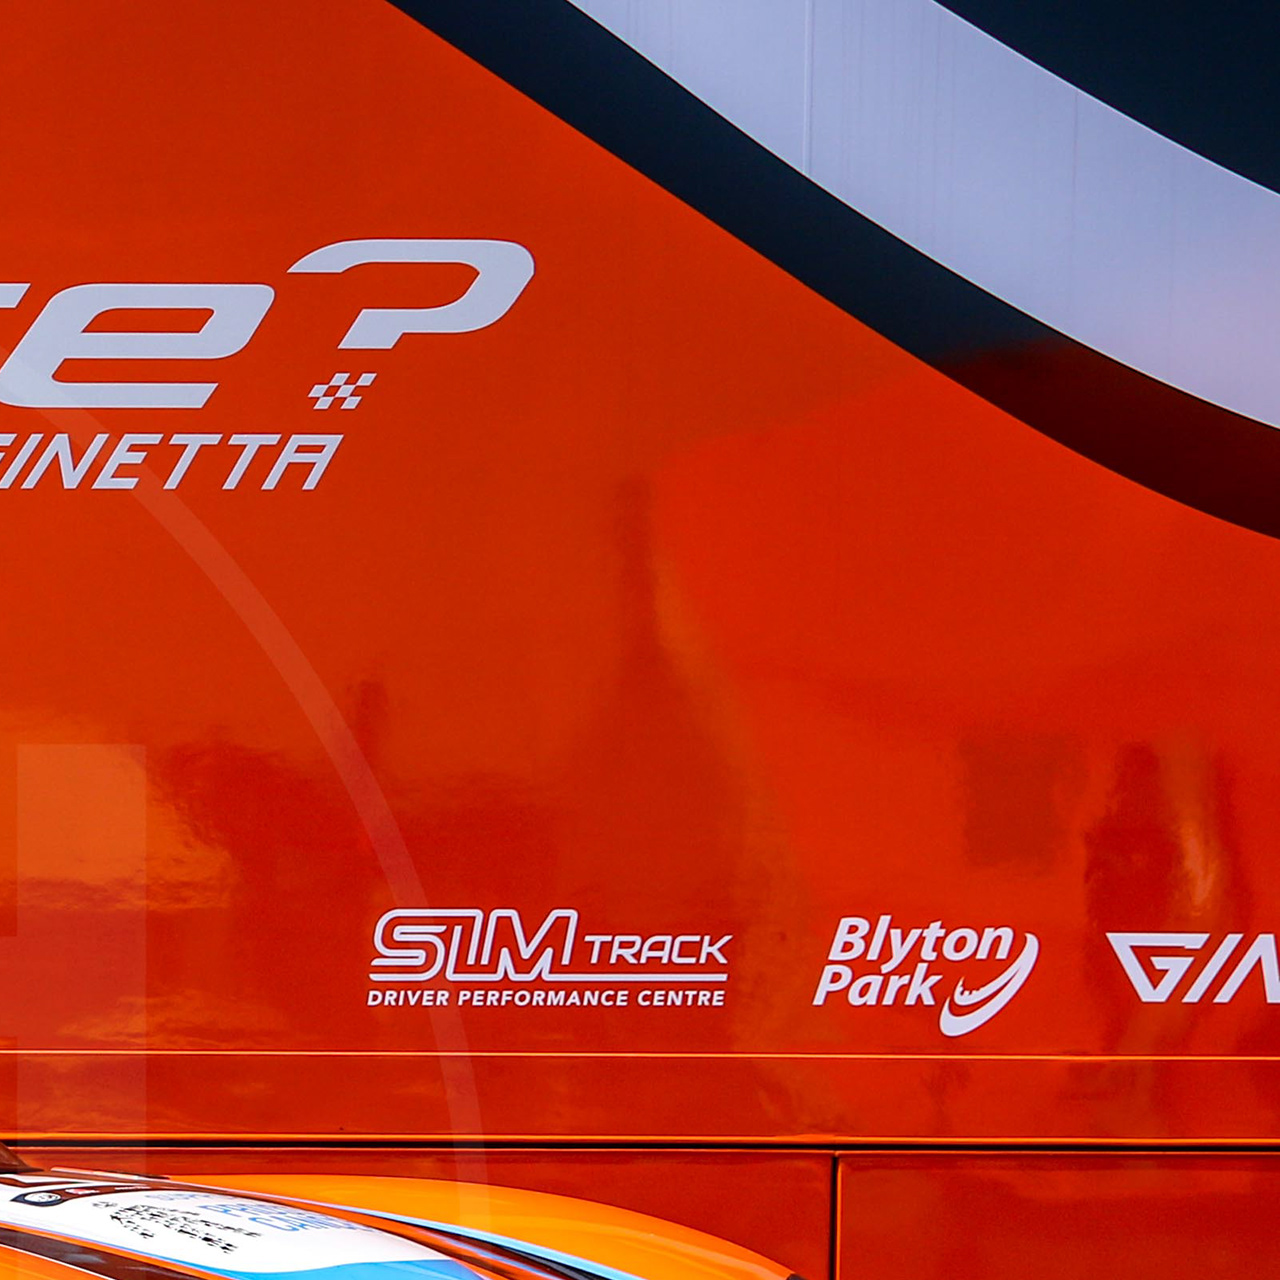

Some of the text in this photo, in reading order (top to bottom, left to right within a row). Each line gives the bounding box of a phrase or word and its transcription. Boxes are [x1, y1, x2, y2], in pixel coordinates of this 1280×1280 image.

[584, 932, 733, 964] TRACK
[827, 914, 1014, 967] Blyton
[367, 989, 725, 1007] DRIVER PERFORMANCE CENTRE
[813, 960, 944, 1007] Park
